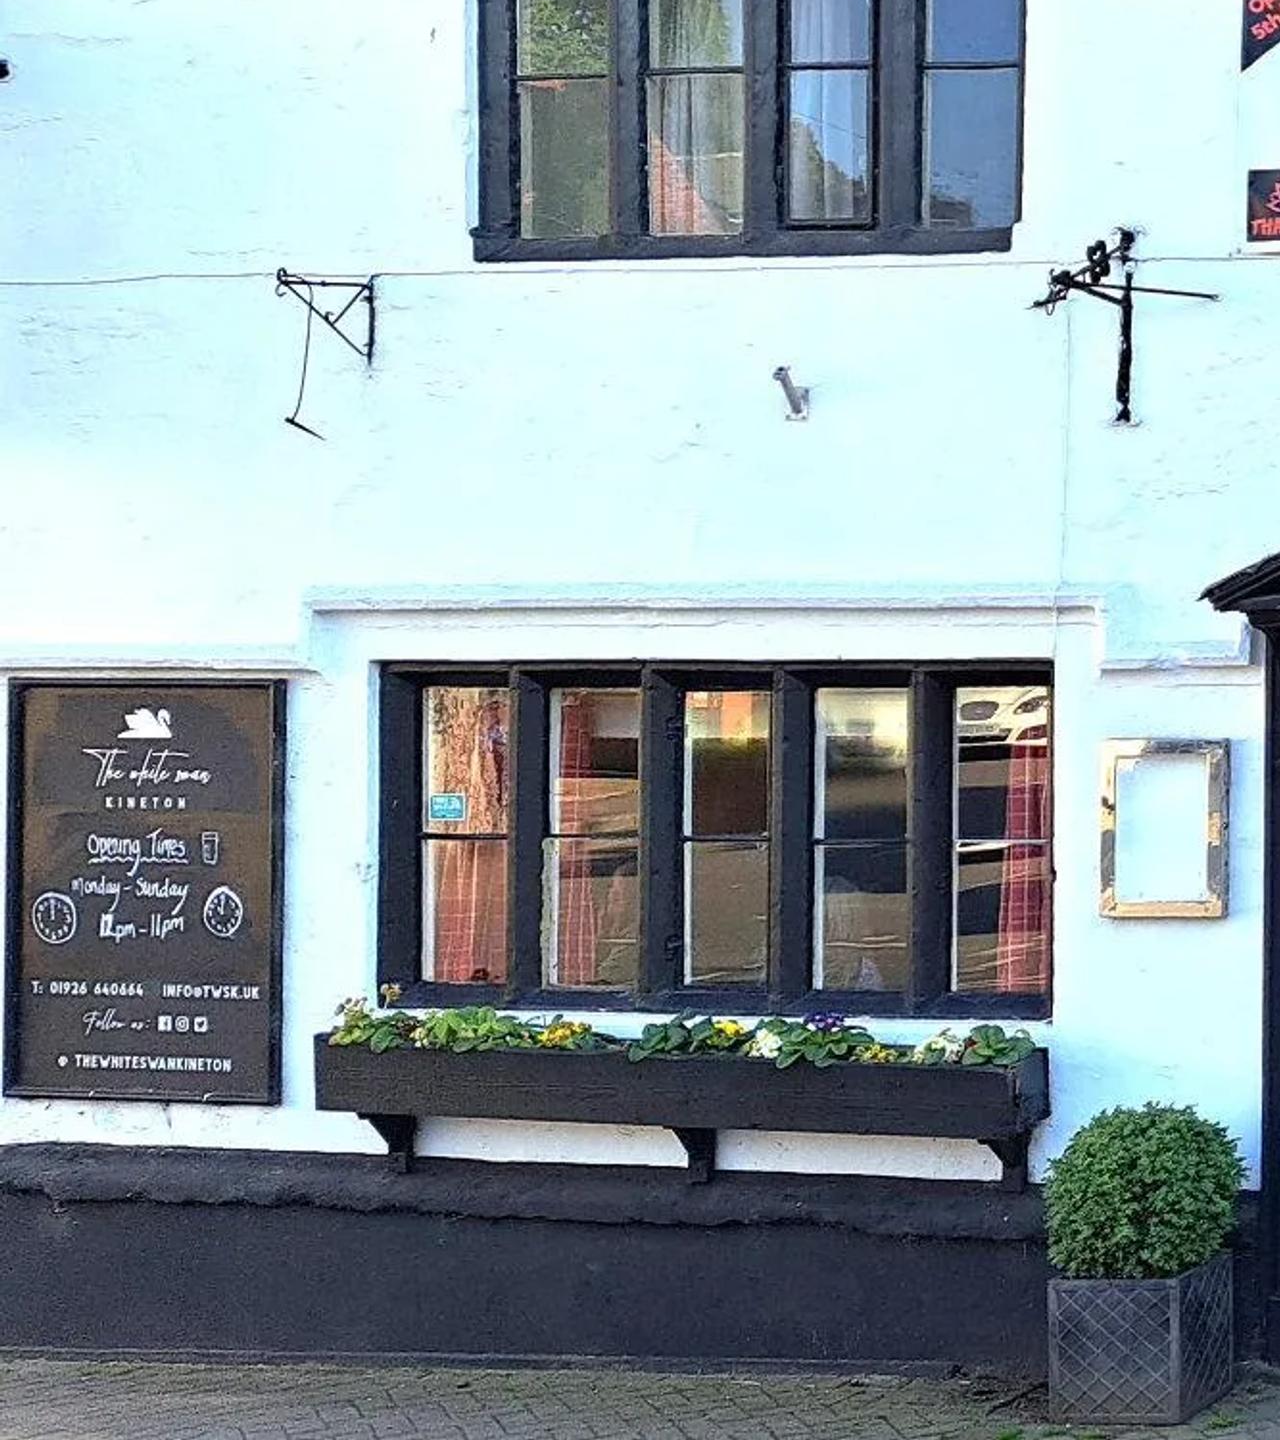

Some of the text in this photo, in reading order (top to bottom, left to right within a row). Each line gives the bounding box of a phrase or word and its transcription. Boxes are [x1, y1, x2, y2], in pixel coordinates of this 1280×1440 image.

[81, 748, 212, 787] The white swan
[104, 796, 187, 809] KINETON
[87, 827, 186, 876] Opening Times
[49, 981, 88, 996] 01926
[82, 1008, 126, 1036] Follow
